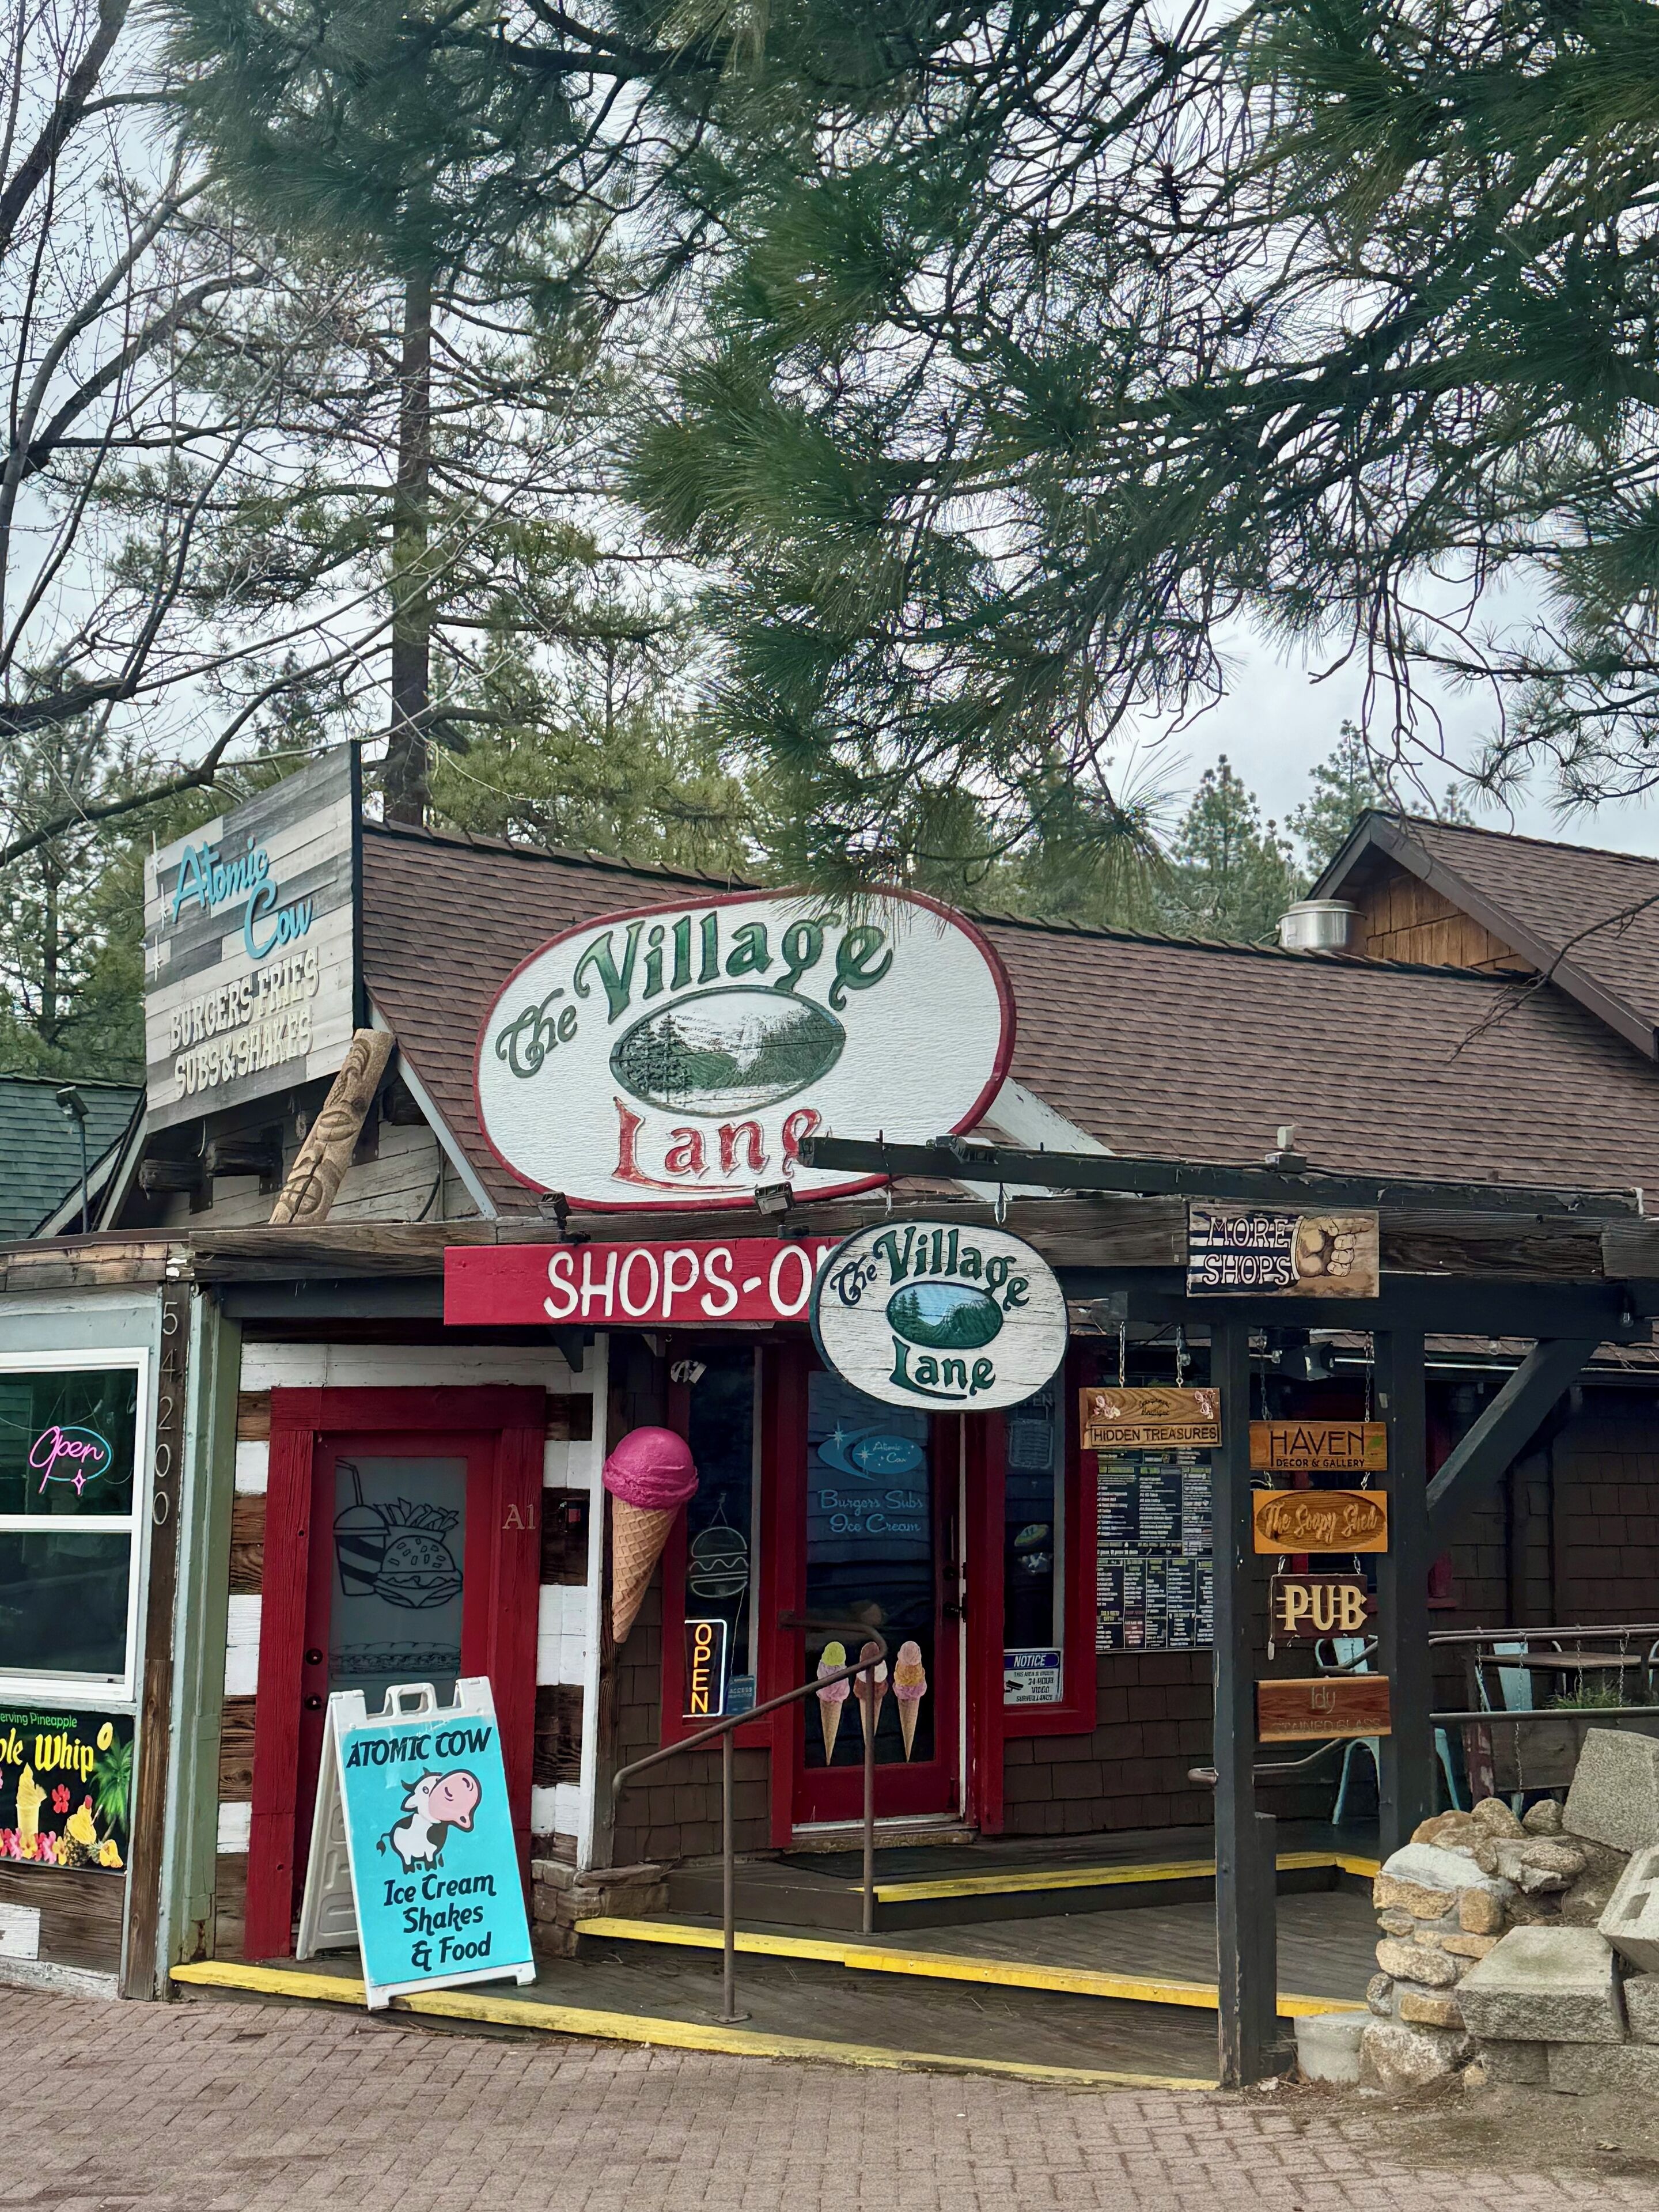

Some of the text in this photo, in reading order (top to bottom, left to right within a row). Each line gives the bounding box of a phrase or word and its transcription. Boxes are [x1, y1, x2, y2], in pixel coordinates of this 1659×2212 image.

[173, 835, 270, 924] Atomic
[244, 878, 313, 960] Cow
[573, 910, 894, 1024] Village
[170, 946, 320, 1053] BURGERS FRIES
[495, 987, 577, 1079] The
[611, 1096, 823, 1193] Lane
[1207, 1217, 1291, 1249] MORE
[830, 1255, 878, 1306] The
[873, 1226, 1030, 1311] Village
[1202, 1255, 1295, 1286] SHOPS
[889, 1335, 997, 1400] Lane
[1094, 1427, 1217, 1441] HIDDEN TREASURES
[1270, 1426, 1365, 1467] HAVEN
[29, 1426, 104, 1494] Open
[1277, 1458, 1365, 1467] DECOR & GALLERY
[817, 1489, 923, 1516] Burgers Subs
[830, 1513, 922, 1533] Ice Cream
[1265, 1502, 1378, 1544] The Soapy Shed
[1283, 1585, 1363, 1631] PUB
[691, 1623, 712, 1714] OPEN
[1014, 1654, 1046, 1667] NOTICE
[29, 1712, 77, 1729] Pineapple
[1336, 1718, 1382, 1732] GLASS
[35, 1732, 94, 1783] Whip
[346, 1727, 492, 1768] ATOMIC COW
[384, 1873, 497, 1906] Ice Cream
[403, 1903, 483, 1936] Shakes
[411, 1931, 491, 1972] & Food
